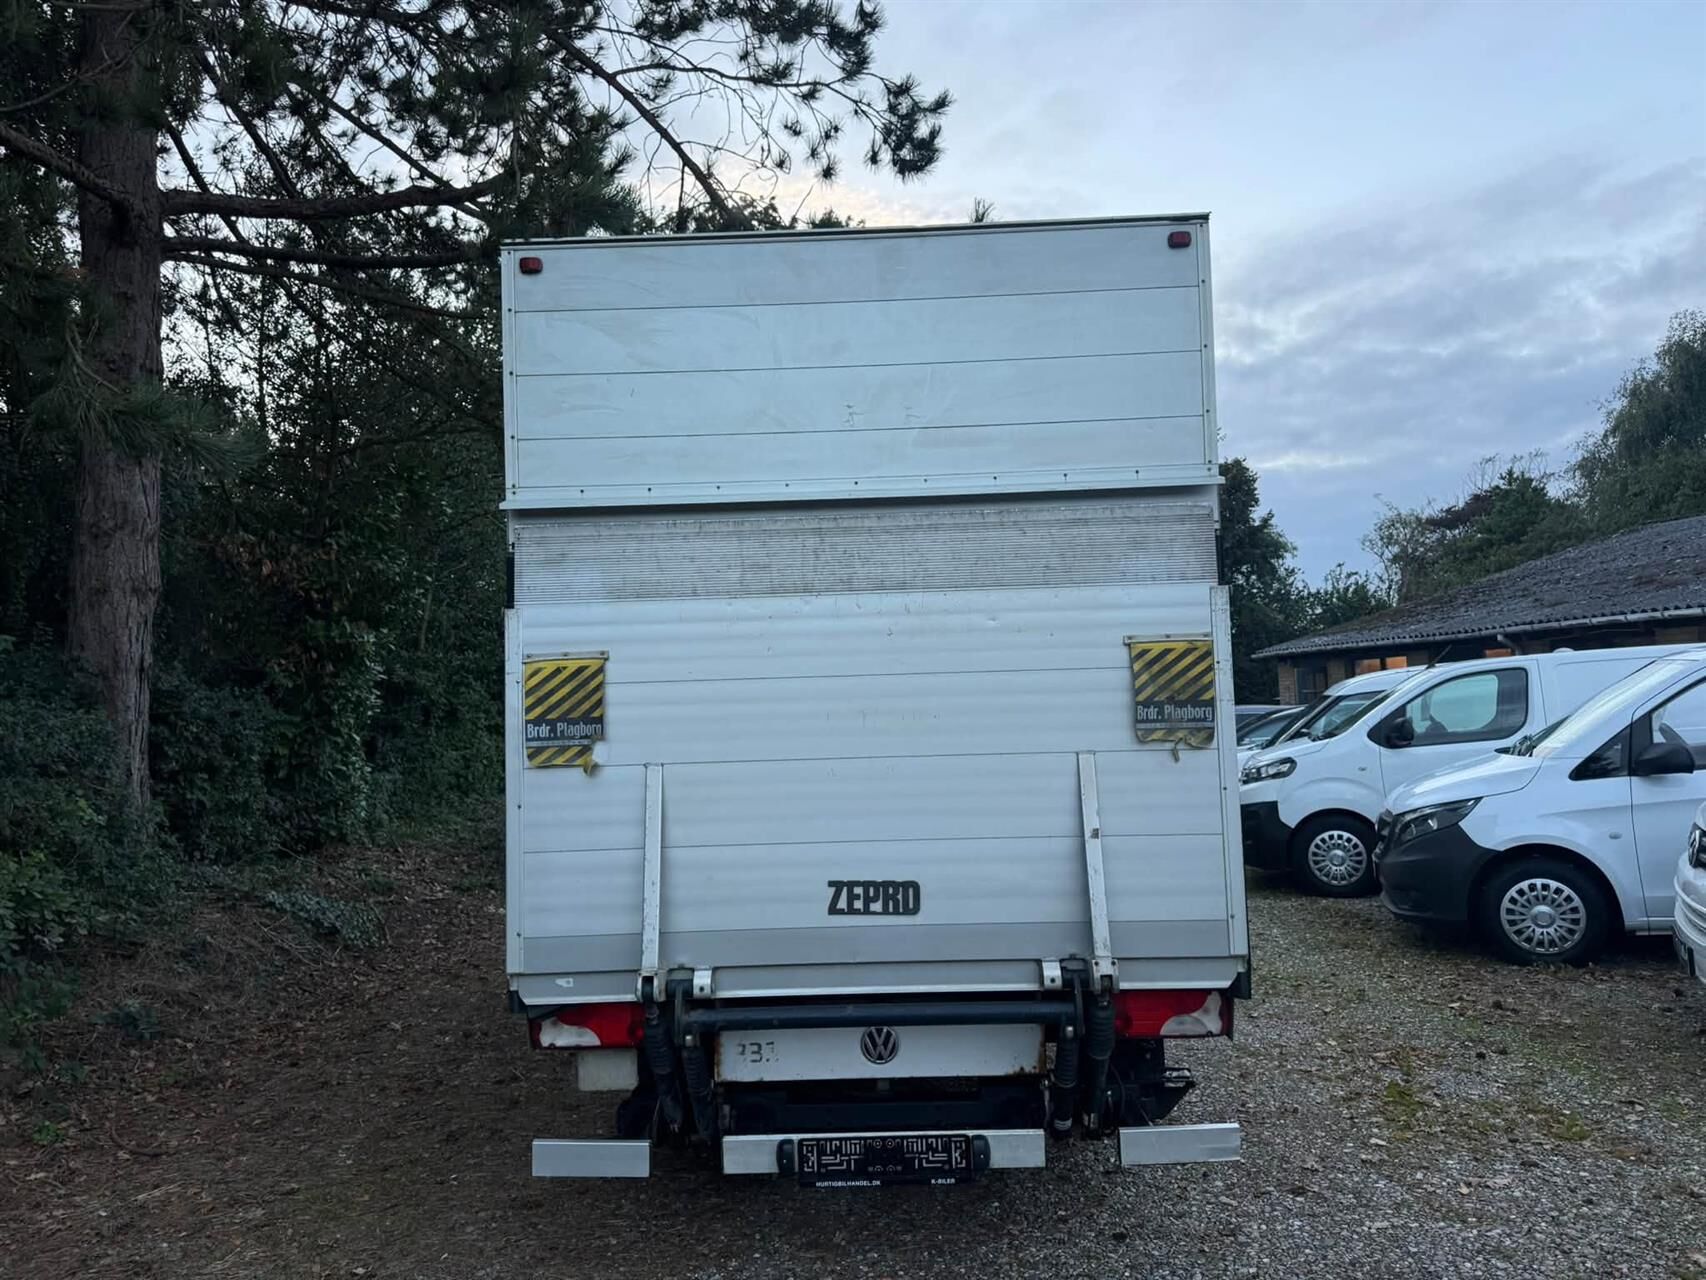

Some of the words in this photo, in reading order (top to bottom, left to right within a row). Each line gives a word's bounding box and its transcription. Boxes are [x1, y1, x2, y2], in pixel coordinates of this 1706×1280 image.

[1136, 704, 1162, 721] Brdr.
[1164, 703, 1213, 722] Plagborg
[526, 722, 554, 739] Brdr.
[827, 880, 921, 916] ZEPRO
